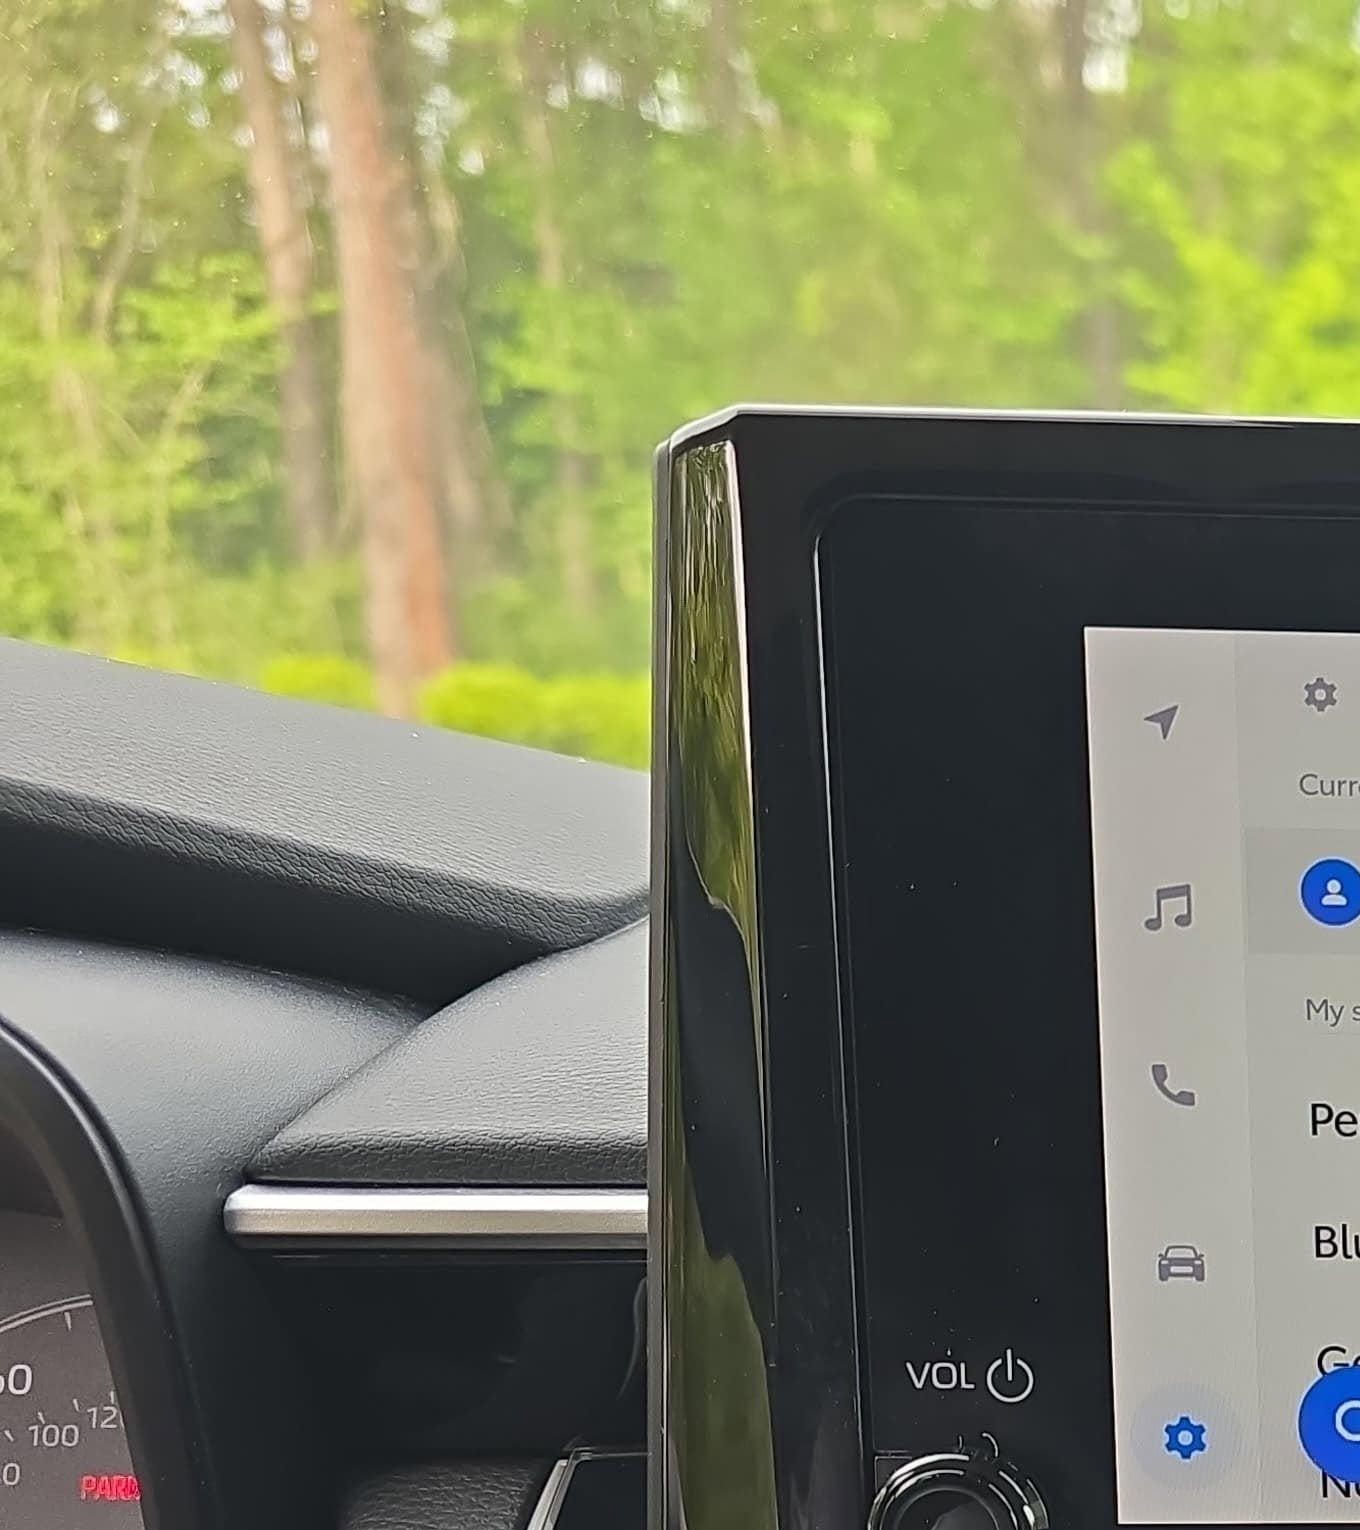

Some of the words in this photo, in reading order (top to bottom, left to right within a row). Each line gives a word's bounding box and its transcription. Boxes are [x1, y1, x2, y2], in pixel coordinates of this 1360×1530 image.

[1306, 998, 1345, 1028] My
[905, 1362, 975, 1389] VOL
[87, 1406, 125, 1429] 12
[28, 1424, 80, 1448] 100
